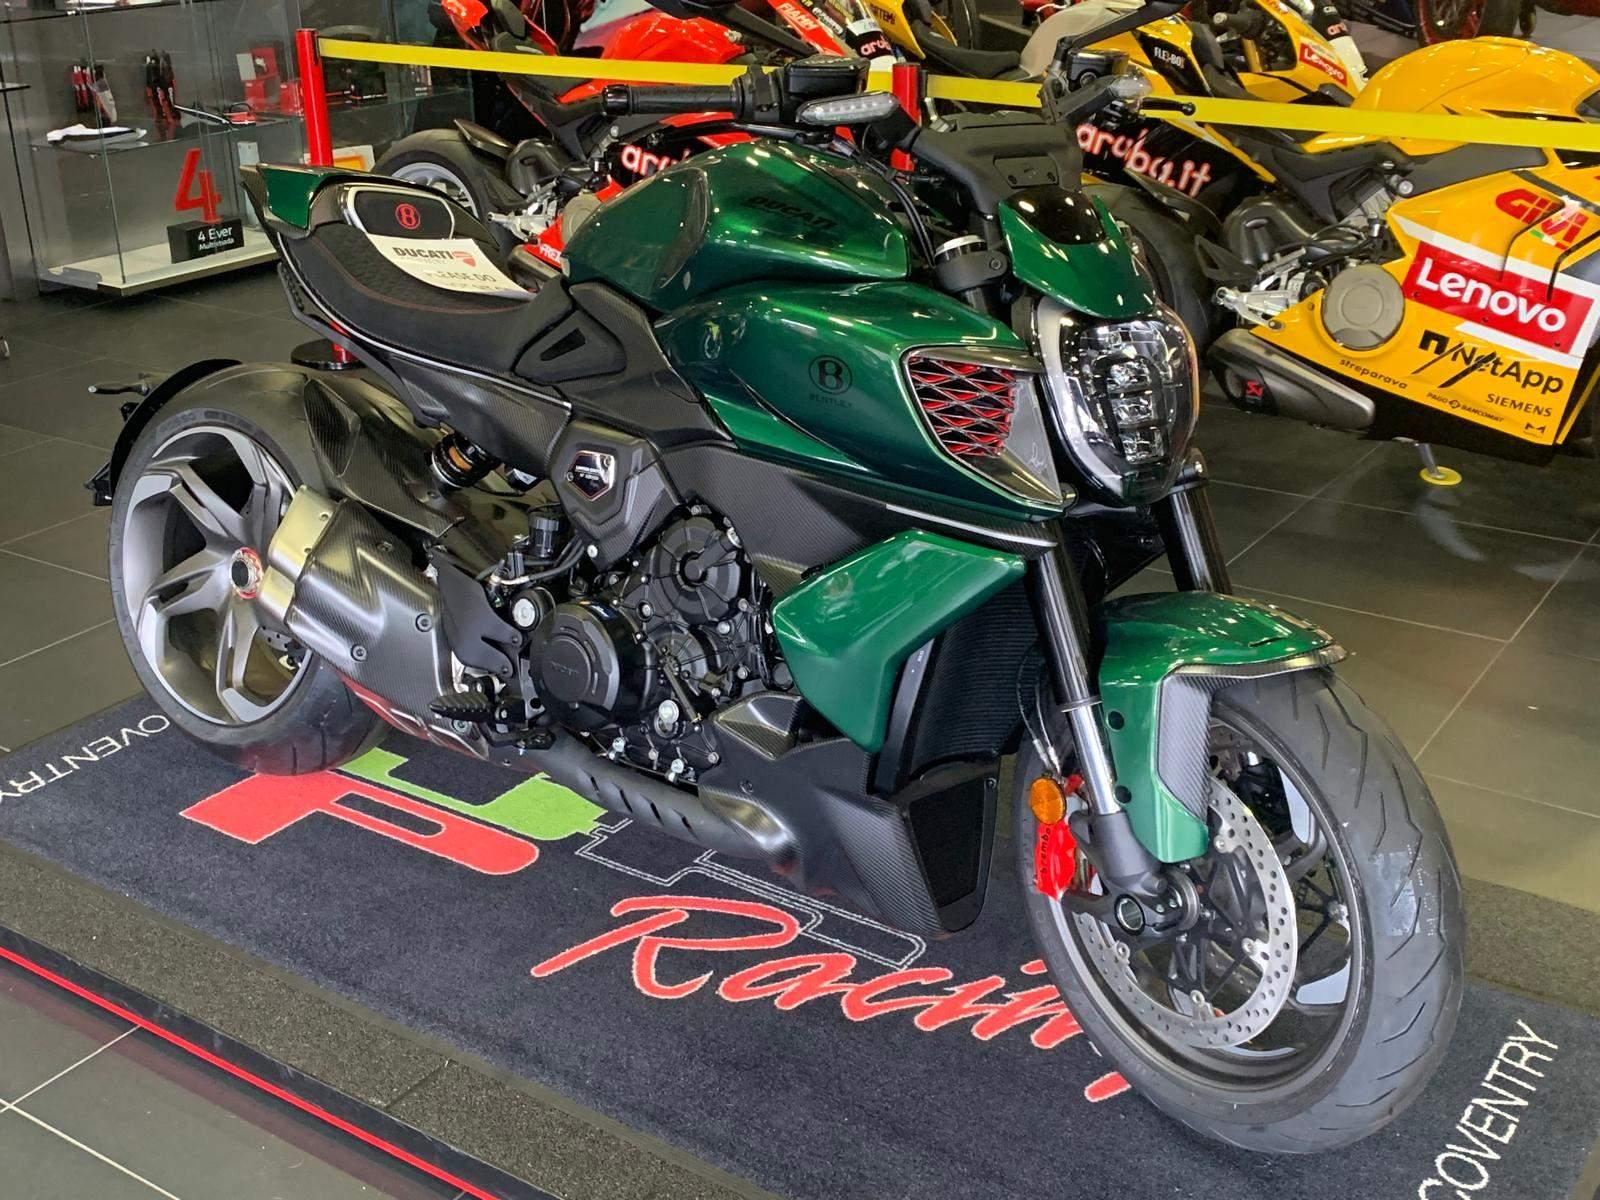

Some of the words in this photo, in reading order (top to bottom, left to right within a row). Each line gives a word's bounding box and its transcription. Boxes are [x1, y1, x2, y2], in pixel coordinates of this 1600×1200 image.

[780, 2, 818, 30] FIAMM
[1303, 47, 1345, 81] Lenovo
[1075, 123, 1212, 198] aruba.it
[176, 148, 222, 222] 4
[198, 231, 206, 242] 4
[208, 227, 233, 240] Ever
[1495, 188, 1589, 243] GIVI
[392, 246, 454, 260] DUCATI
[1416, 257, 1567, 333] Lenovo
[1339, 357, 1408, 390] streparava
[1451, 345, 1564, 395] NetApp
[1486, 392, 1553, 417] SIEMENS
[1040, 827, 1051, 874] brembo
